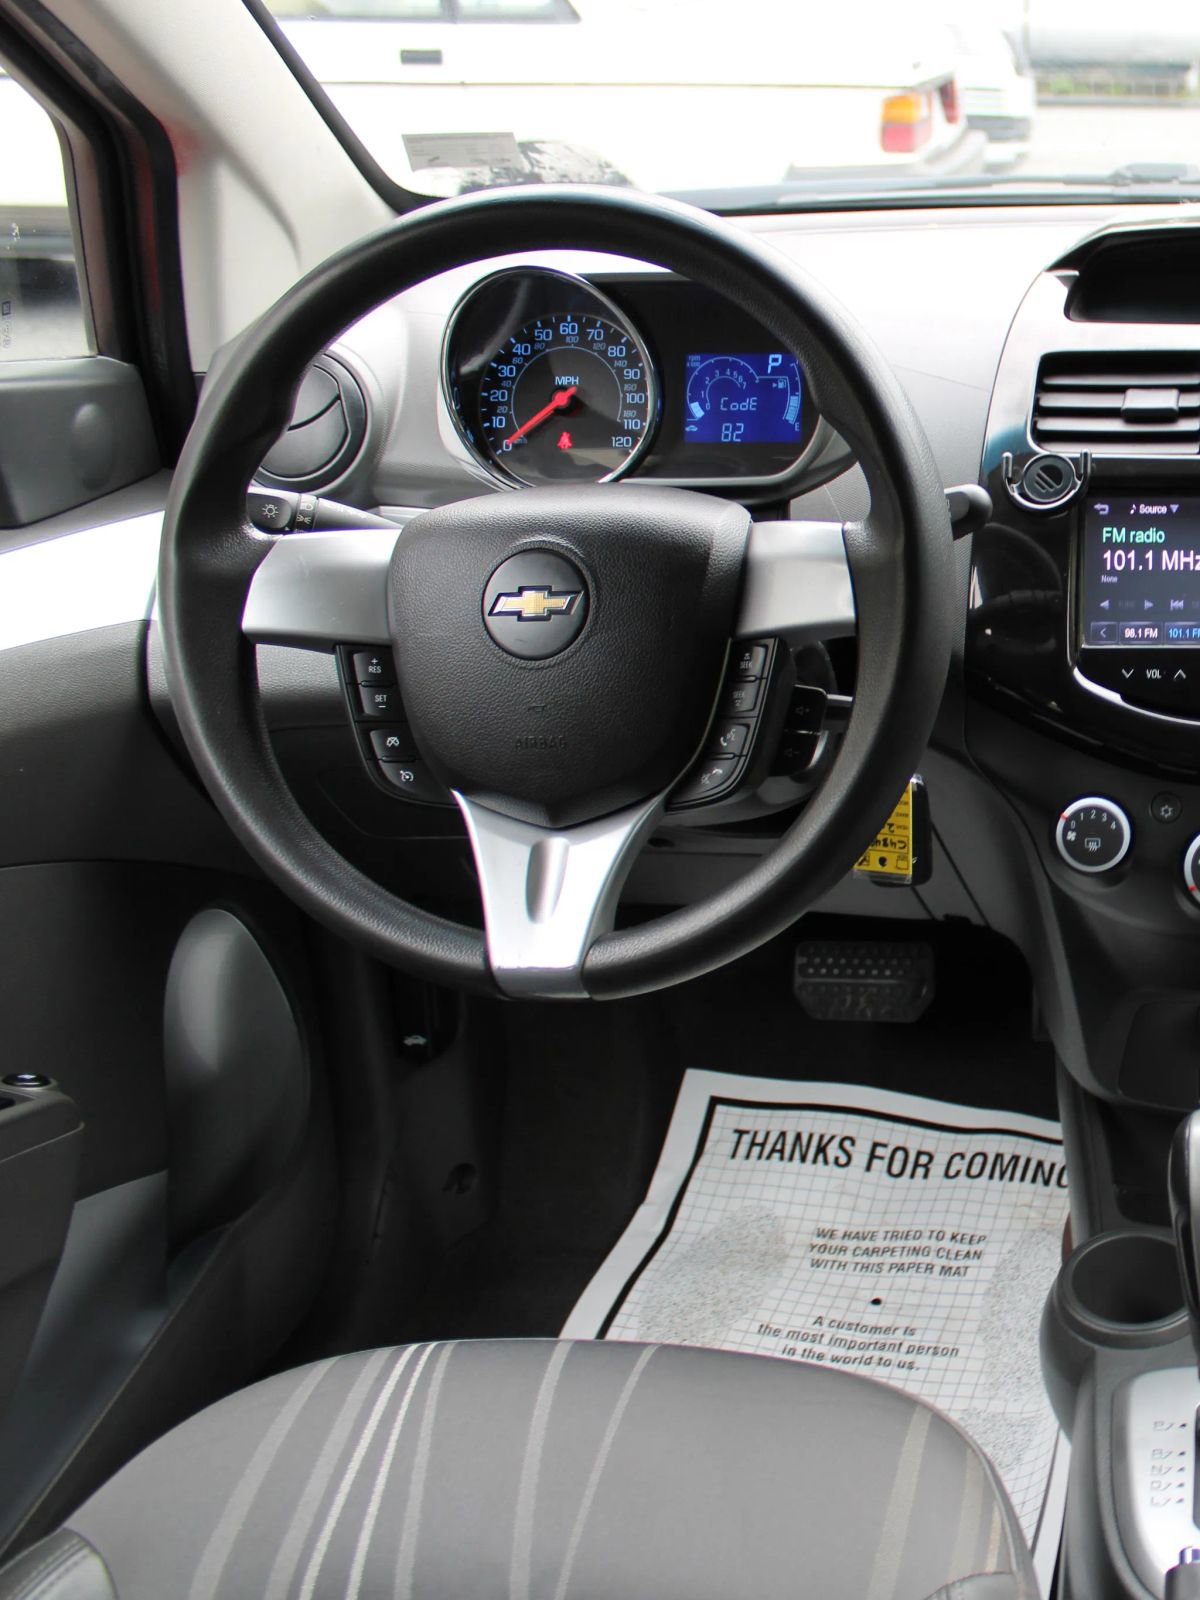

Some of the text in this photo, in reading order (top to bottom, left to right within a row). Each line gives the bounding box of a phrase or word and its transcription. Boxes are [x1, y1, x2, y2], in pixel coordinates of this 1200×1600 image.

[534, 329, 552, 341] 50
[559, 323, 578, 335] 60
[586, 329, 603, 341] 70
[512, 343, 531, 355] 40
[608, 346, 625, 357] 80
[768, 354, 782, 373] P
[498, 365, 516, 377] 30
[624, 369, 640, 380] 90
[555, 376, 579, 385] MPH
[490, 391, 508, 402] 20
[626, 393, 644, 404] 100
[492, 416, 506, 428] 10
[623, 419, 641, 430] 110
[721, 423, 744, 442] 82
[503, 440, 513, 451] 0
[611, 437, 632, 447] 120
[1139, 503, 1168, 515] Source
[1102, 527, 1166, 543] FM radio
[1103, 549, 1153, 571] 101.1
[1101, 575, 1118, 583] None
[1143, 627, 1159, 639] FM
[1168, 627, 1190, 639] 101.1
[368, 665, 381, 673] RES
[1146, 668, 1162, 679] VOL
[374, 694, 388, 702] SET
[1080, 812, 1084, 821] 1
[1091, 809, 1097, 819] 2
[1102, 812, 1107, 822] 3
[1070, 820, 1076, 829] 0
[1110, 821, 1117, 830] 4
[731, 1128, 856, 1168] THANKS
[865, 1140, 934, 1180] FOR
[816, 1227, 987, 1246] WE HAVE TRIED TO KEEP
[809, 1243, 983, 1261] YOUR CARPETING CLEAN
[810, 1258, 970, 1277] WITH THIS PAPER MAT
[812, 1316, 917, 1337] A customer is
[757, 1322, 960, 1358] the most important person
[781, 1344, 920, 1372] in the world to us.
